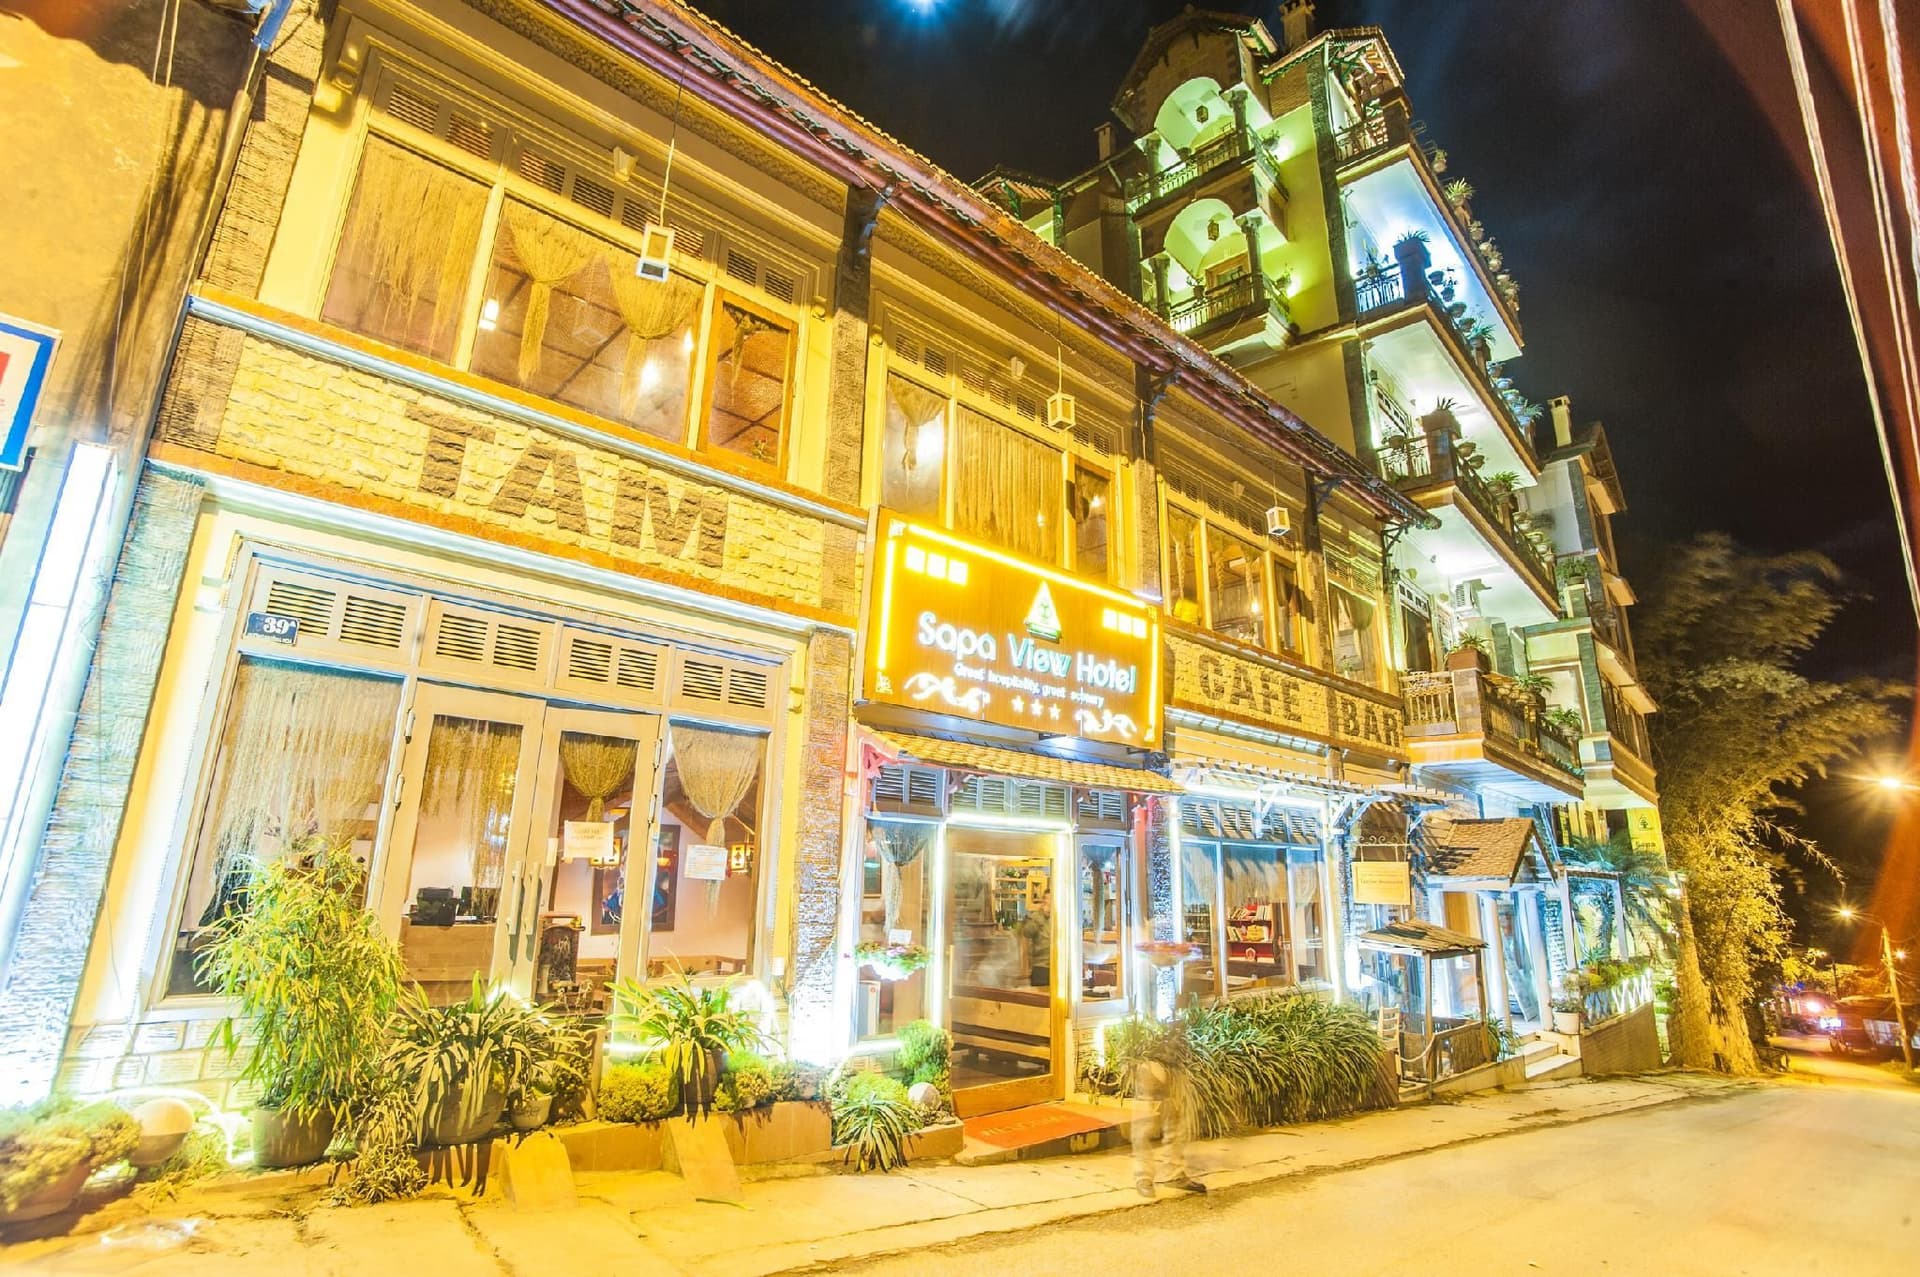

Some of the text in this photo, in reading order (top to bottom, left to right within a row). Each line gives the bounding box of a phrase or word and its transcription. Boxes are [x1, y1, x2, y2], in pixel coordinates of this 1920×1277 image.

[403, 404, 728, 569] TAM
[918, 611, 1137, 694] Sapa View Hotel
[1200, 654, 1400, 748] CAFE BAR
